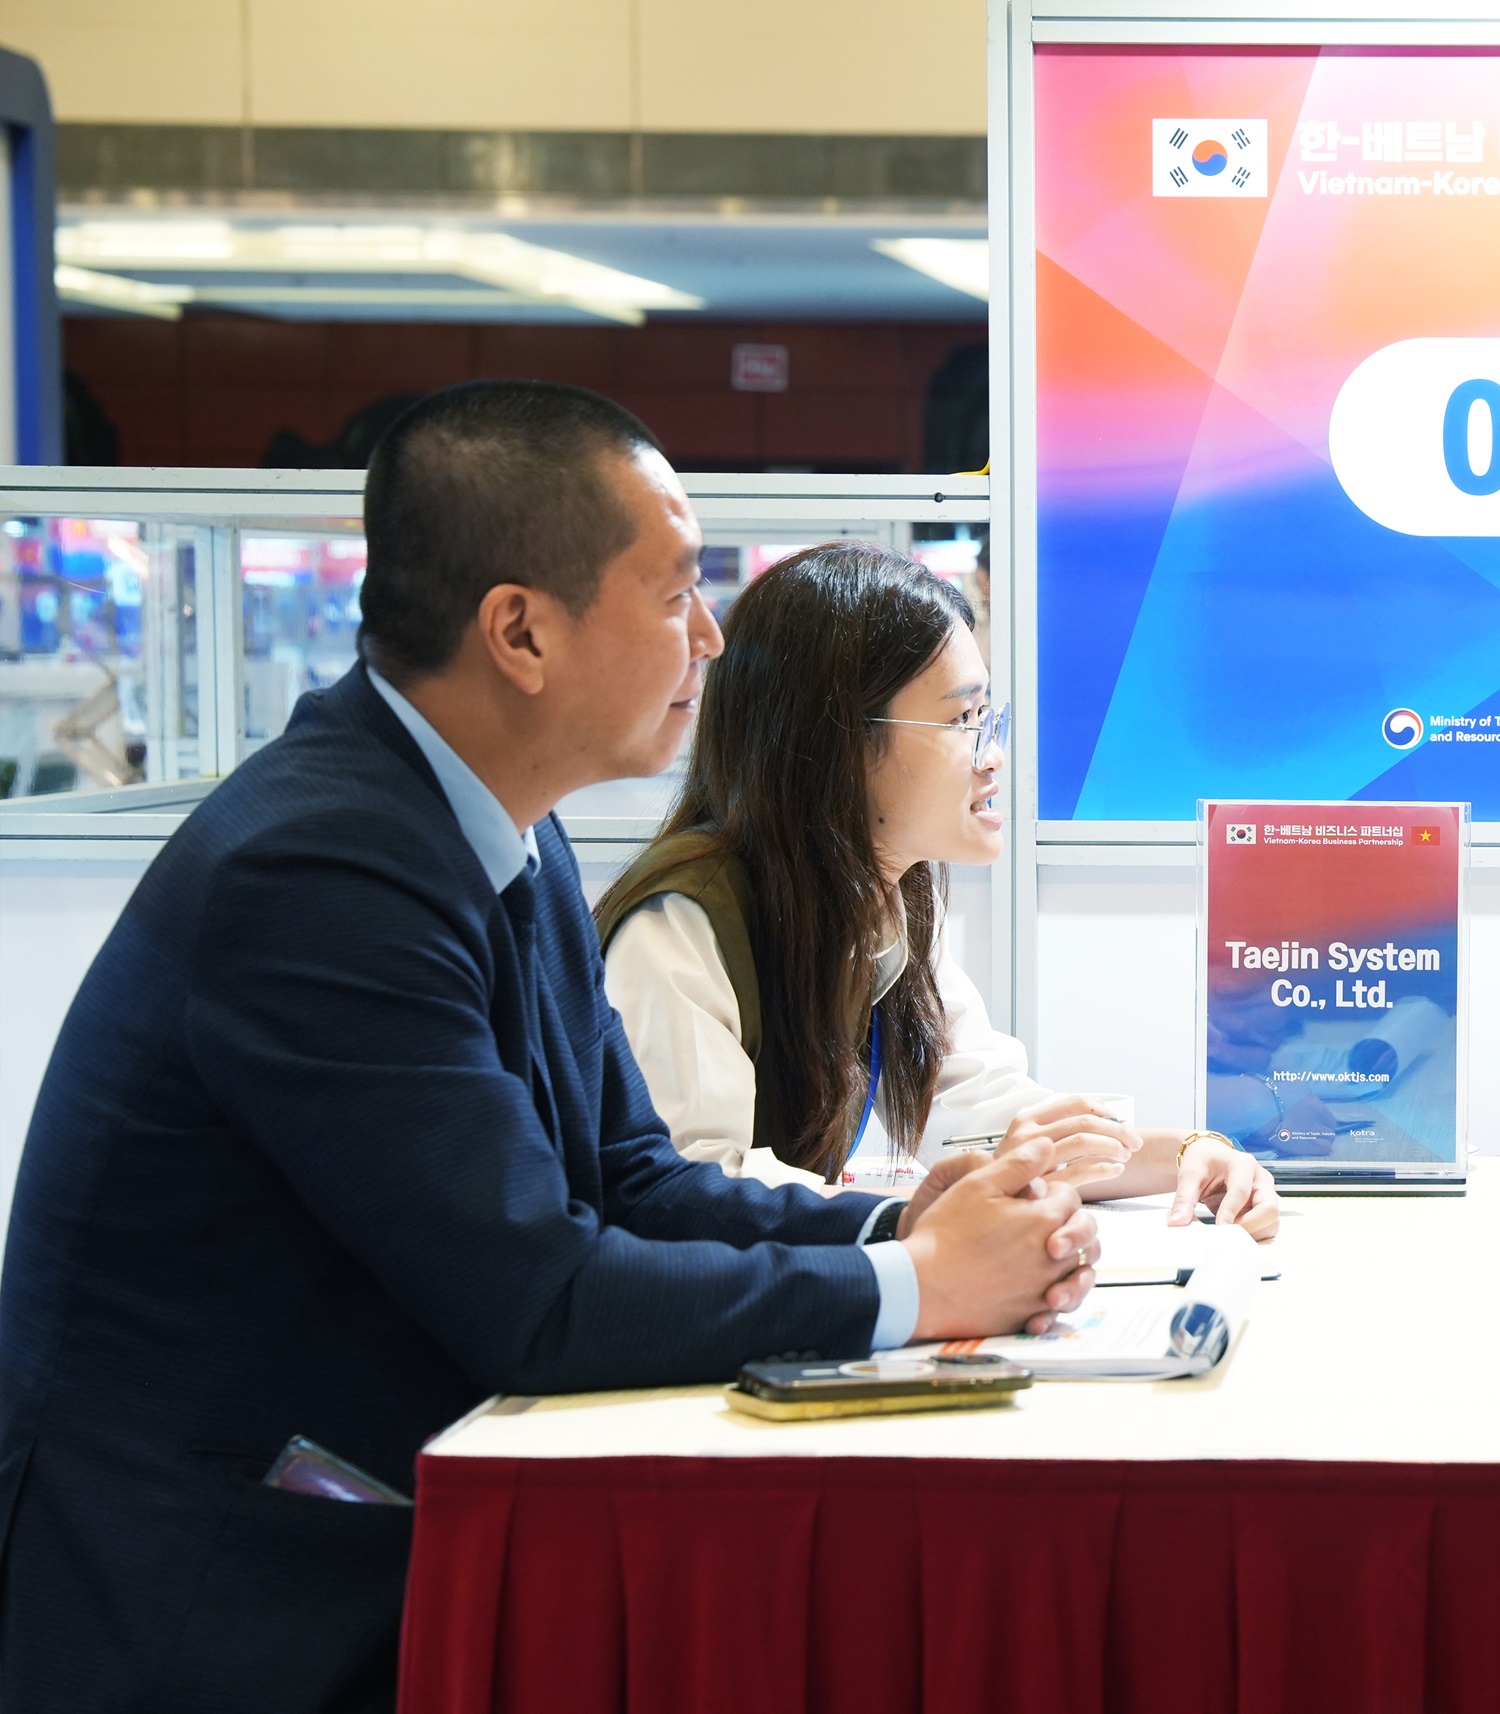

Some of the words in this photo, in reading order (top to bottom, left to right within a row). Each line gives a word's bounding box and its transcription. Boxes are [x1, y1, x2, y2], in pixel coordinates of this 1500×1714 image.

[1299, 120, 1486, 162] 한-베트남
[1429, 716, 1476, 730] Ministry
[1479, 715, 1492, 727] of
[1429, 730, 1452, 742] and
[1263, 824, 1312, 838] 한-베트남
[1315, 824, 1358, 838] 비즈니스
[1360, 825, 1404, 838] 파트너십
[1263, 837, 1321, 845] Vietnam-Korea
[1322, 837, 1357, 846] Business
[1358, 838, 1404, 847] Partnership
[1225, 941, 1319, 972] Taejin
[1328, 942, 1440, 973] System
[1271, 979, 1326, 1010] Co.,
[1335, 979, 1394, 1009] Ltd.
[1350, 1129, 1375, 1137] kotra
